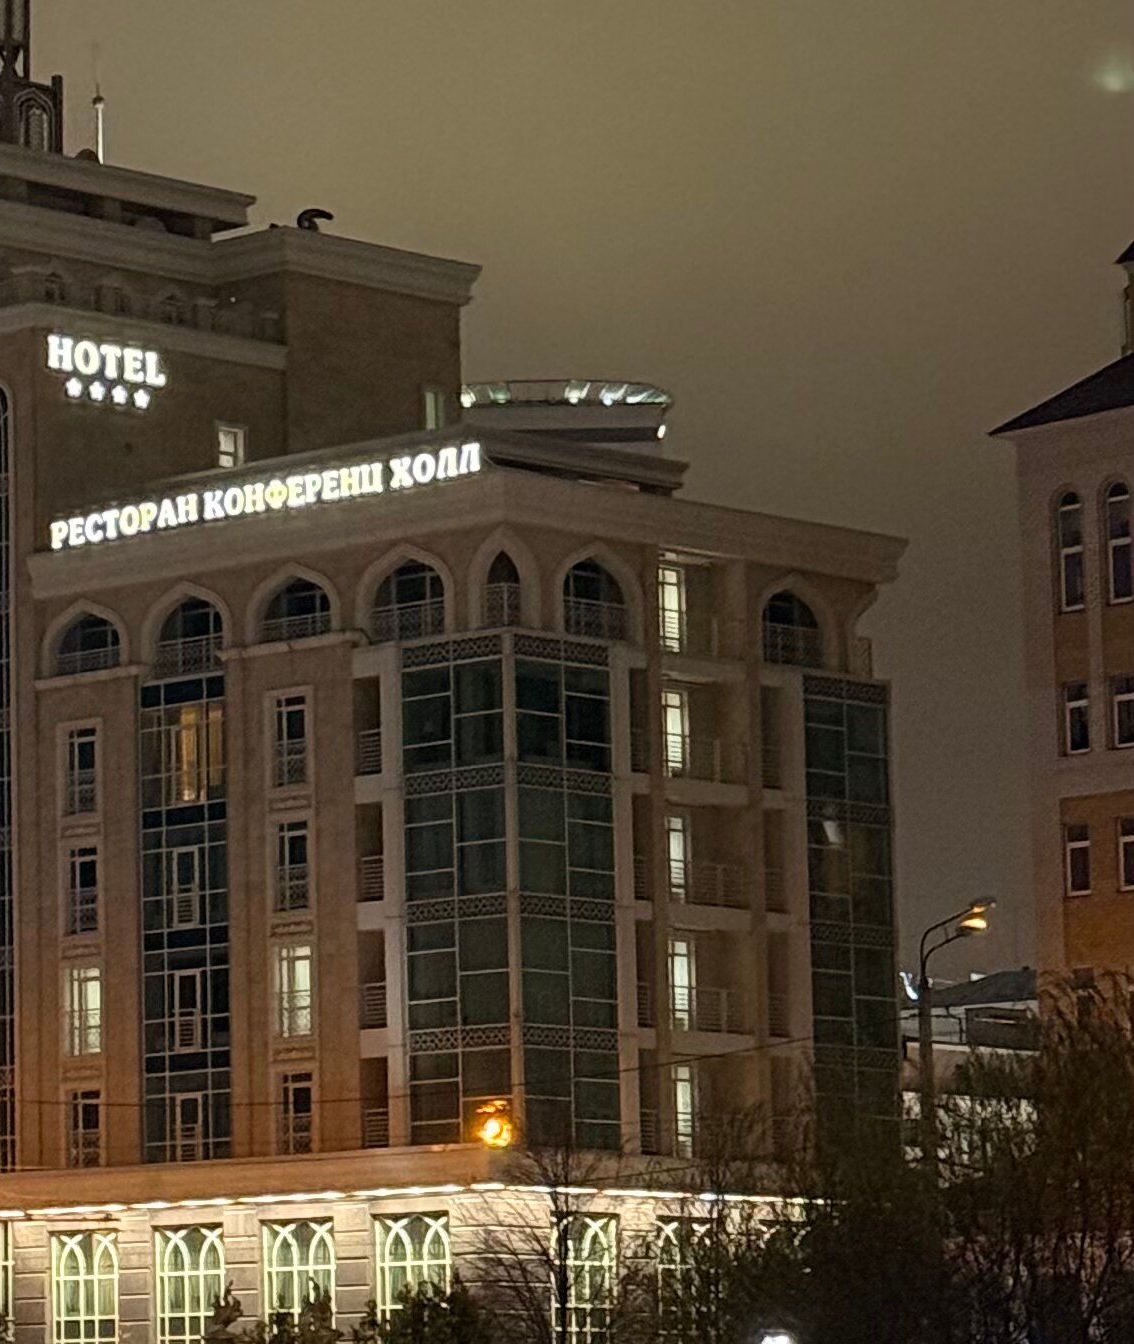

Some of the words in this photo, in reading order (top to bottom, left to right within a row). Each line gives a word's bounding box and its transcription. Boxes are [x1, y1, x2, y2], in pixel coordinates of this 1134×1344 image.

[46, 334, 167, 388] HOTEL
[50, 493, 199, 550] РЕСТОРАН
[202, 462, 384, 520] КОНФЕРЕНЦ
[389, 442, 482, 490] ХОЛЛ
